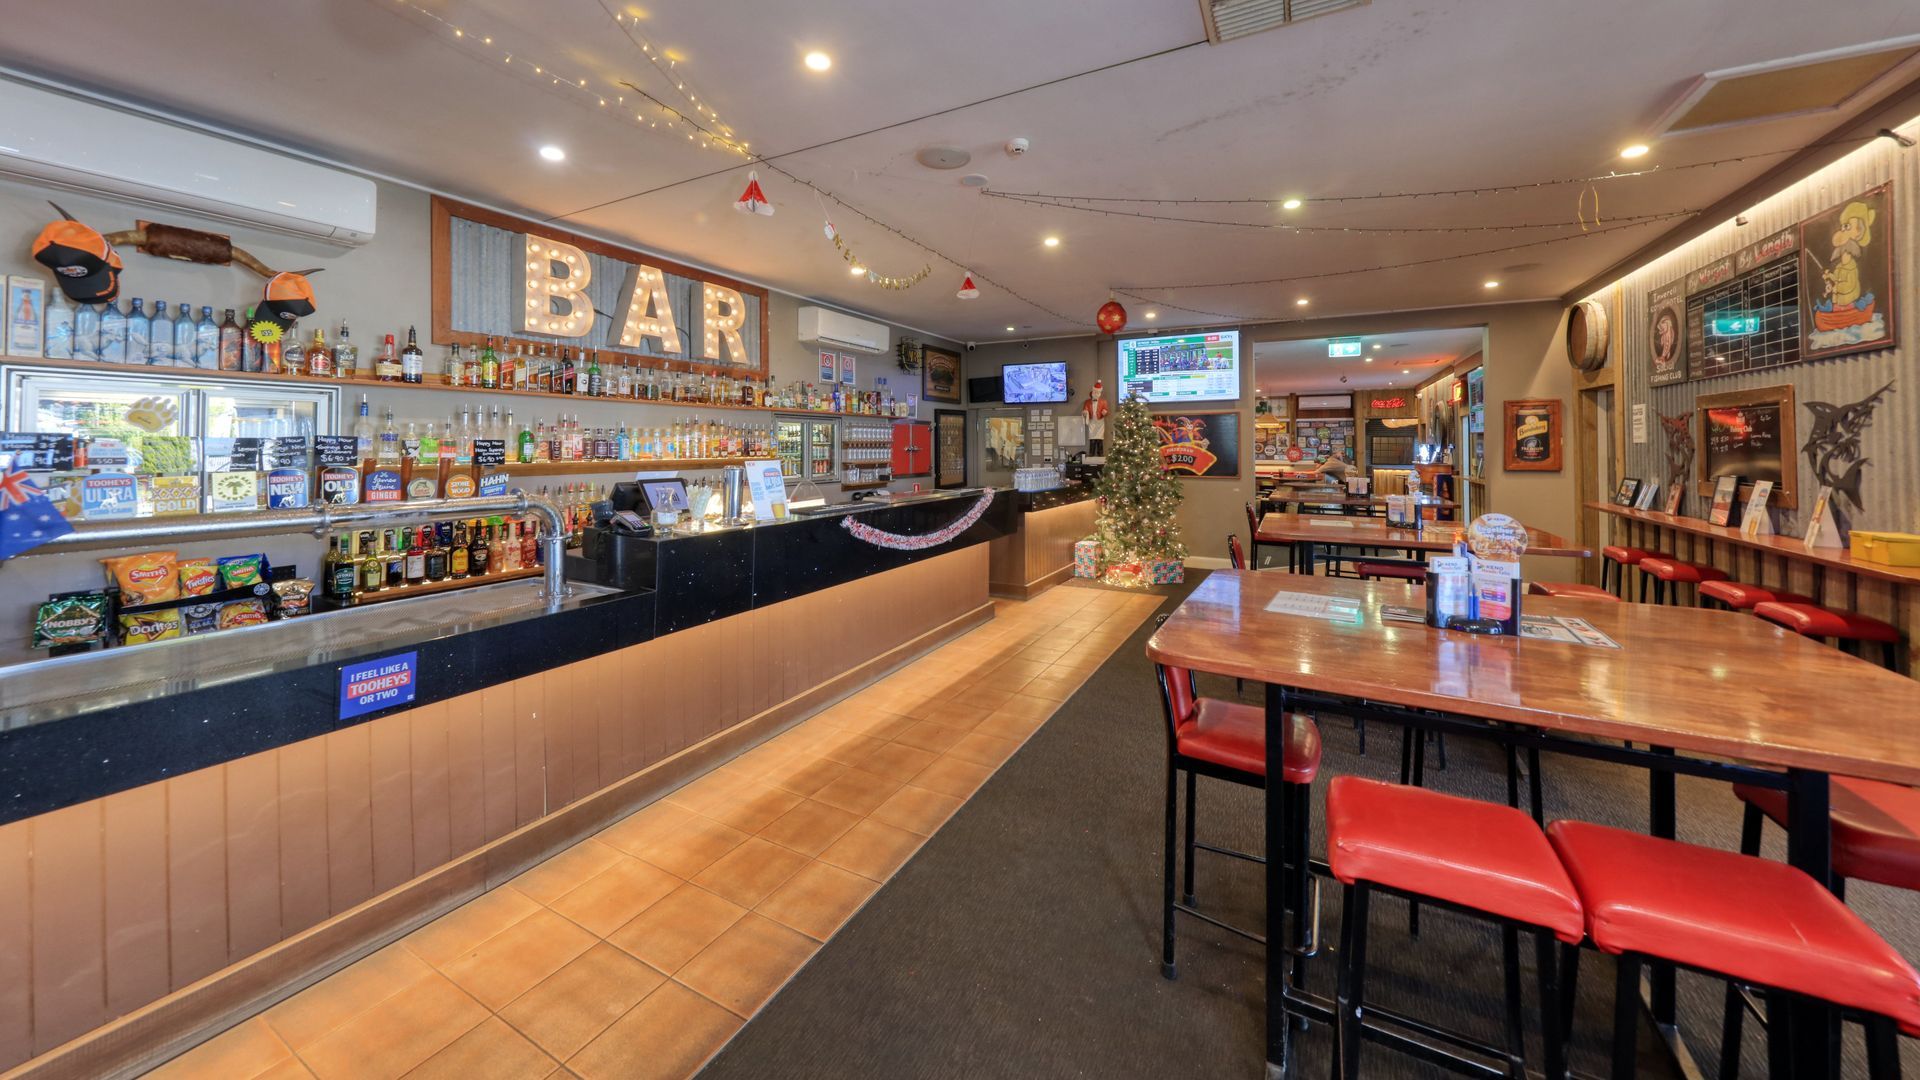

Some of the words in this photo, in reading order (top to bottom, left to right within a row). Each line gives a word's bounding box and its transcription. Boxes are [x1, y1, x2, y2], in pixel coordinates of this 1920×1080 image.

[1754, 230, 1793, 262] Length
[512, 233, 748, 364] BAR
[1669, 371, 1682, 380] CLUB
[88, 479, 132, 487] TOOHEYS
[325, 480, 354, 492] OLD
[480, 473, 509, 487] HAHN
[86, 487, 134, 502] ULTRA
[270, 484, 304, 496] NEW
[371, 490, 398, 499] GINGER
[157, 500, 196, 512] GOLD
[186, 575, 215, 589] Twisties
[48, 617, 97, 629] NOBBY'S
[350, 674, 355, 683] I
[356, 669, 379, 681] FEEL
[380, 663, 401, 676] LIKE
[401, 662, 409, 671] A
[350, 673, 408, 696] TOOHEYS
[360, 695, 375, 705] OR
[375, 688, 399, 701] TWO
